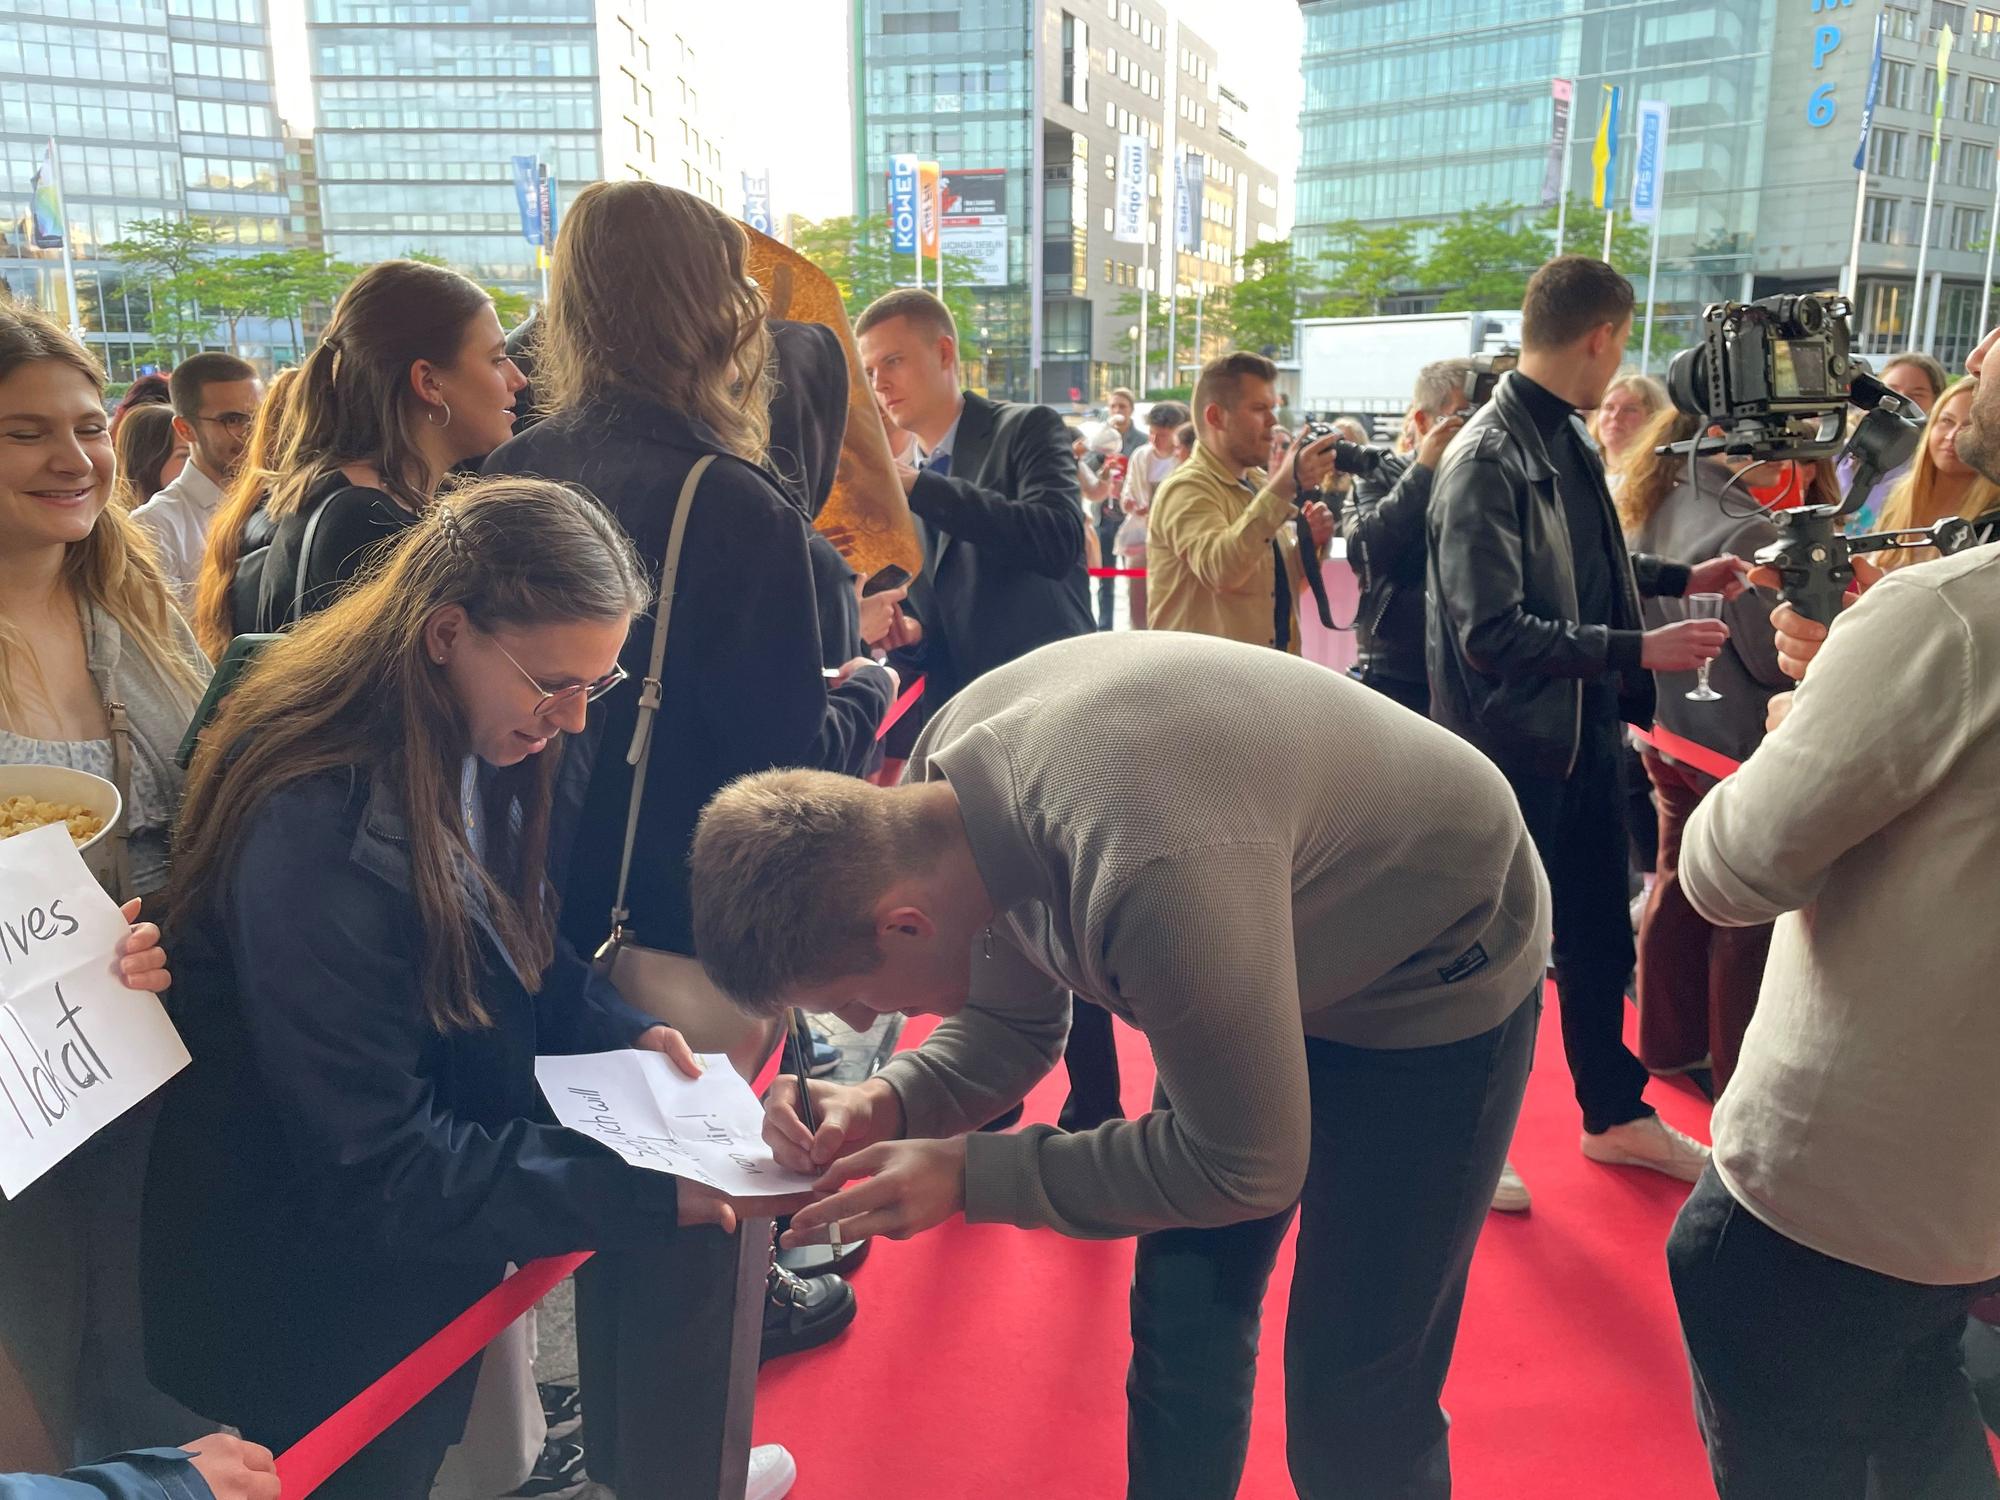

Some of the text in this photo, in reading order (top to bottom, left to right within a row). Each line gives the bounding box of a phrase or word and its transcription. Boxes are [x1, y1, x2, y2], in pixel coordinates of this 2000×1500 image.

[568, 1087, 609, 1112] will
[579, 1115, 626, 1135] ich
[728, 1153, 764, 1175] von
